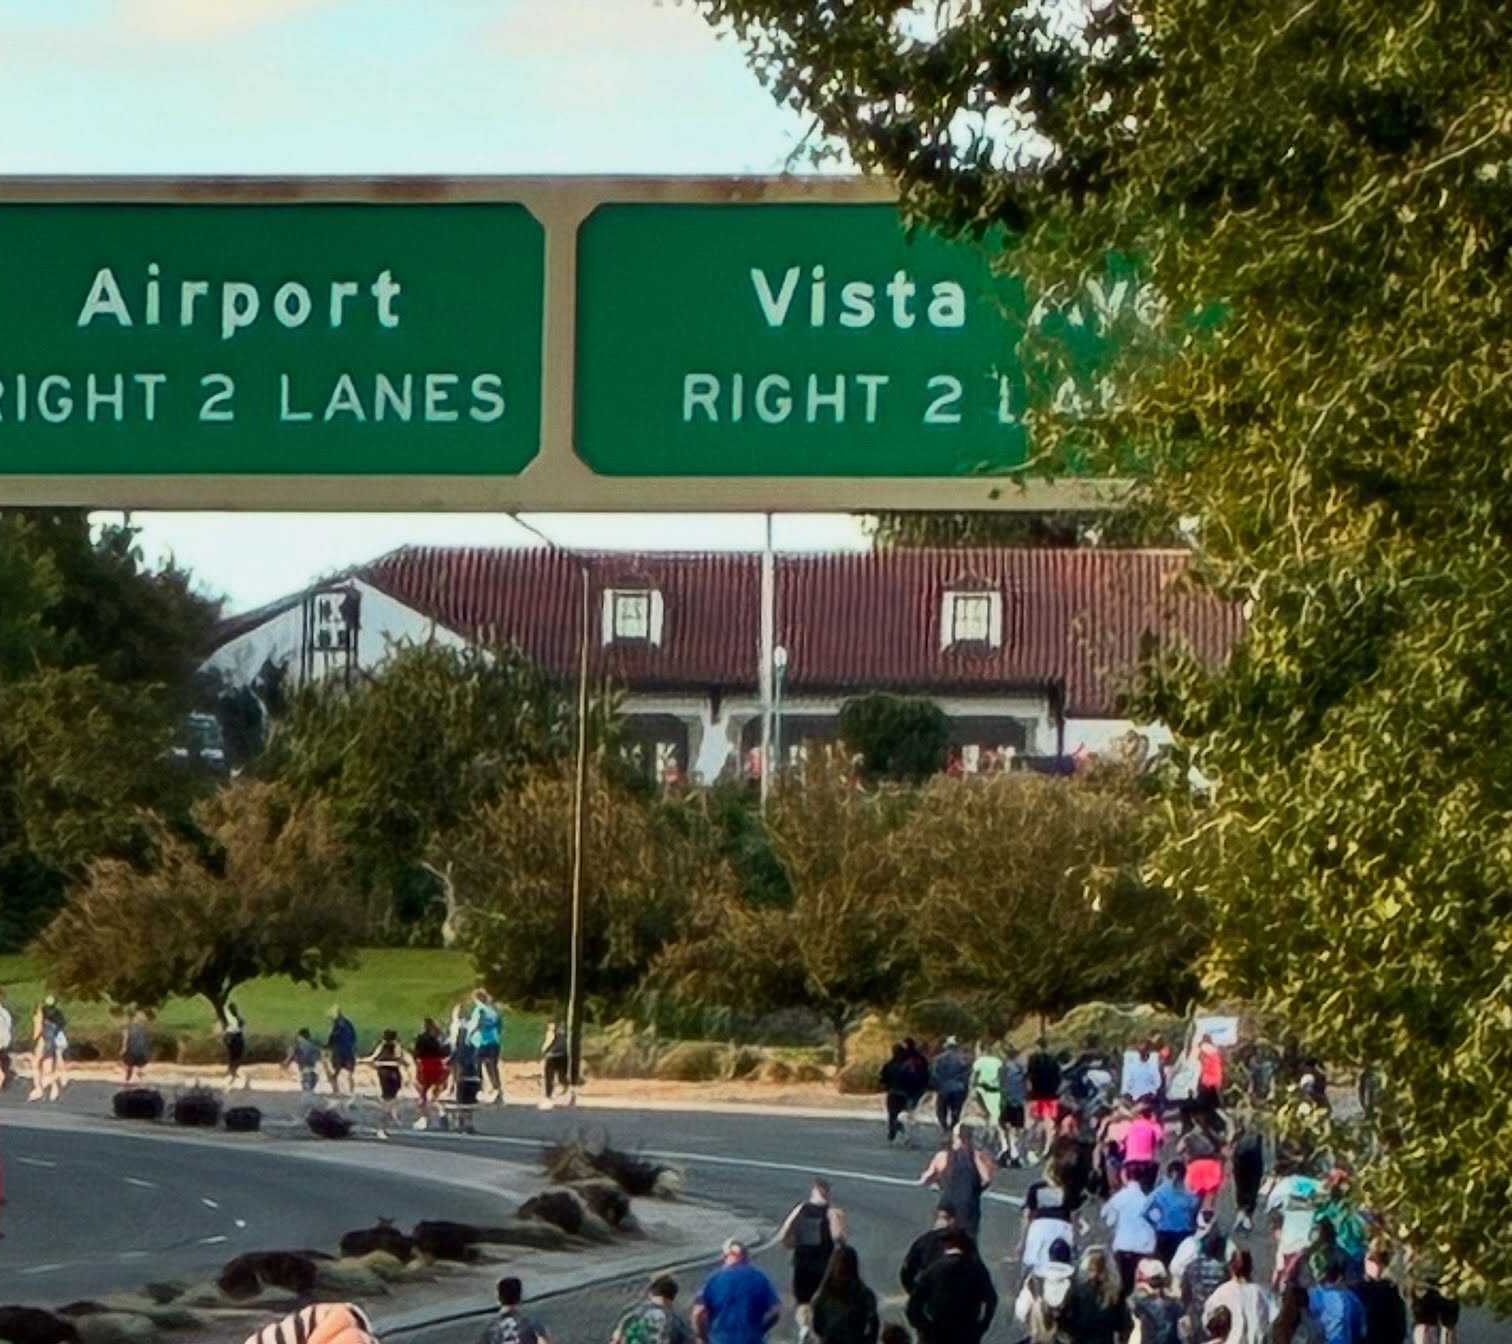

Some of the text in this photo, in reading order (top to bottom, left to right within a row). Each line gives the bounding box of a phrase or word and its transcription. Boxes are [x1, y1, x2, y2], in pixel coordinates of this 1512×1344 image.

[77, 263, 402, 339] Airport
[750, 265, 966, 328] Vista
[199, 374, 235, 421] 2
[280, 373, 505, 422] LANES
[683, 374, 889, 423] RIGHT
[924, 375, 963, 423] 2
